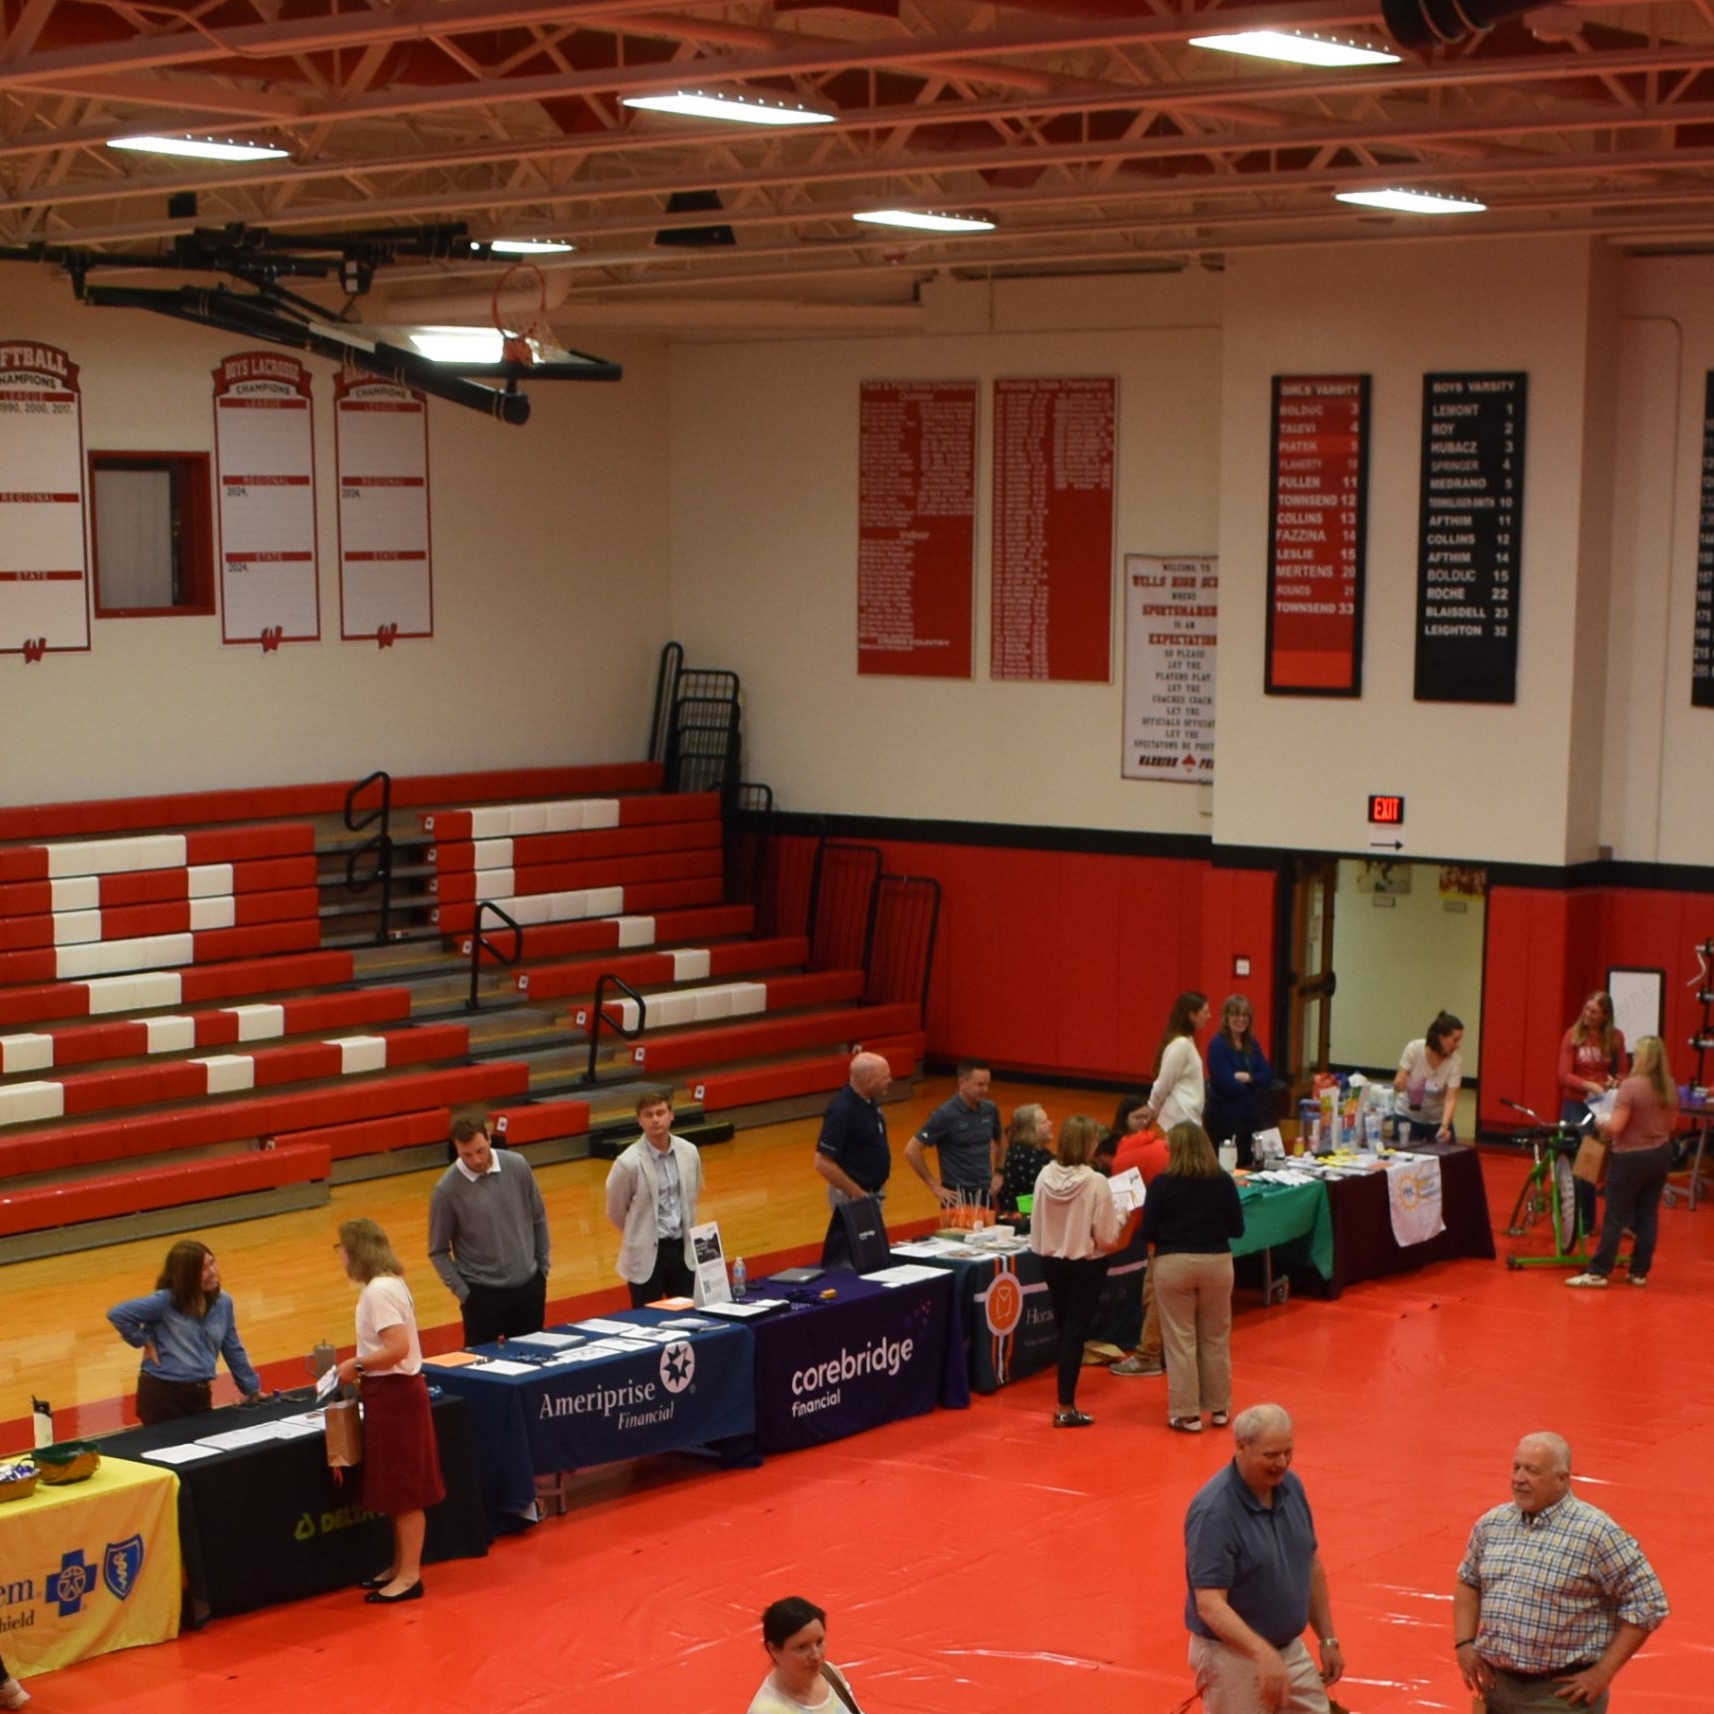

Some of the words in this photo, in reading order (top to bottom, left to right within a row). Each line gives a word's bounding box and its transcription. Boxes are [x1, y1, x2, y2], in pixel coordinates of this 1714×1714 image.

[236, 382, 290, 396] CHAMPIONS
[1373, 797, 1399, 821] EXIT
[791, 1336, 914, 1395] corebridge
[539, 1379, 656, 1420] Ameriprise
[792, 1388, 841, 1418] financial
[617, 1400, 675, 1430] Financial
